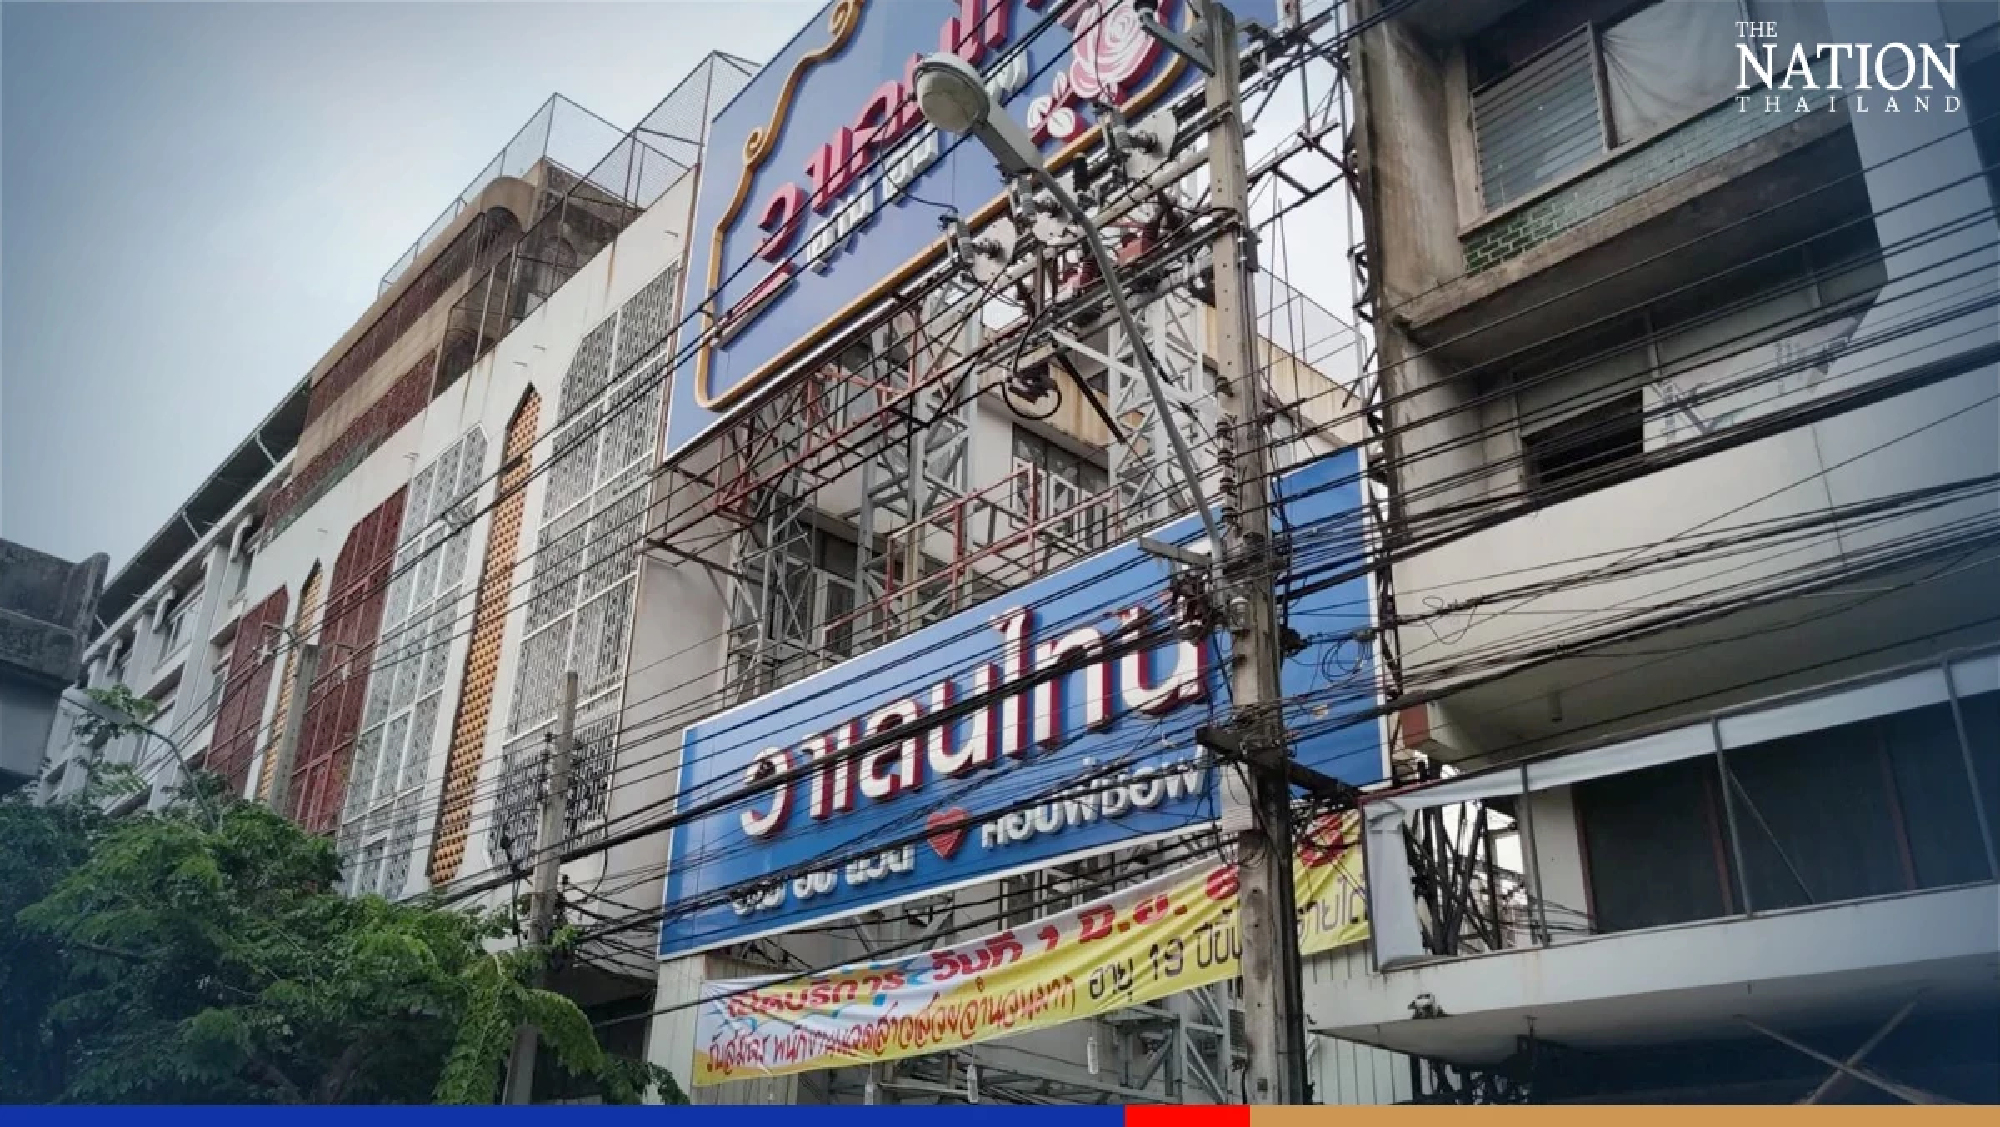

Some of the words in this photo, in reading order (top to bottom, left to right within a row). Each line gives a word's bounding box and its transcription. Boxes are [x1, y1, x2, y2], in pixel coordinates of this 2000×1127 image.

[740, 604, 1209, 838] วาเลนไทน
[1149, 937, 1185, 981] 19
